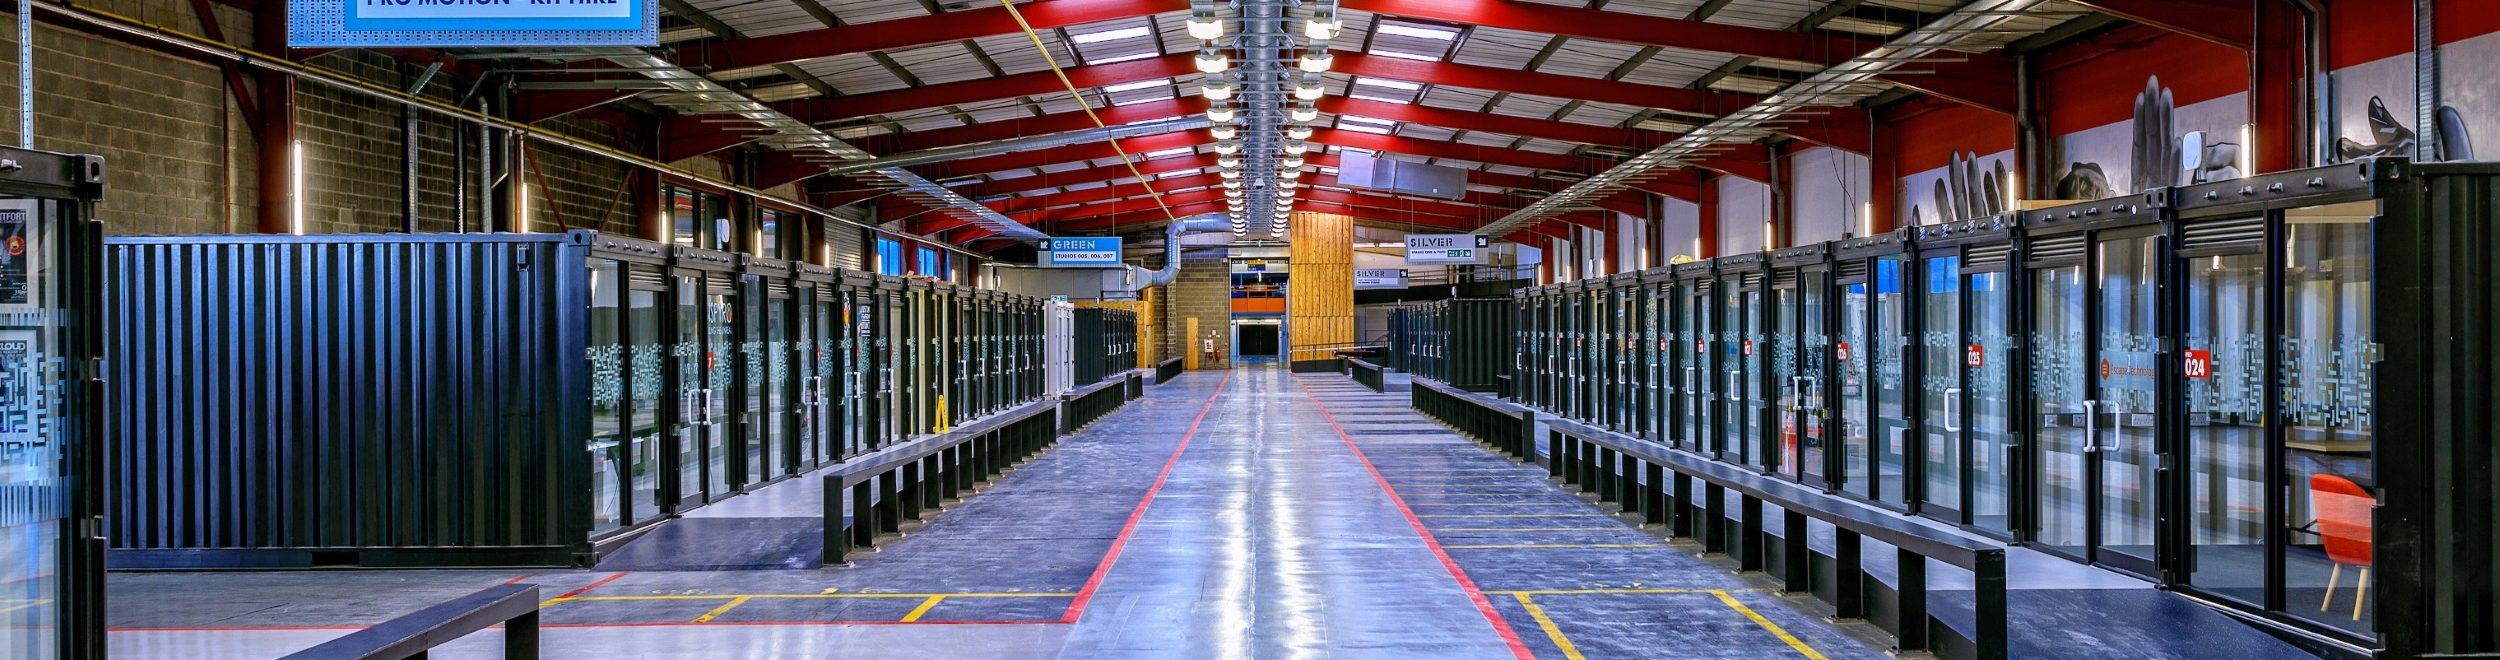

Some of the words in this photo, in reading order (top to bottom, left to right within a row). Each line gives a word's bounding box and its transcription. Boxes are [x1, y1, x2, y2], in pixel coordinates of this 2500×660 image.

[1053, 240, 1095, 249] GREEN
[1410, 238, 1453, 247] SILVER
[1968, 351, 1980, 365] 025
[2185, 358, 2205, 376] 024
